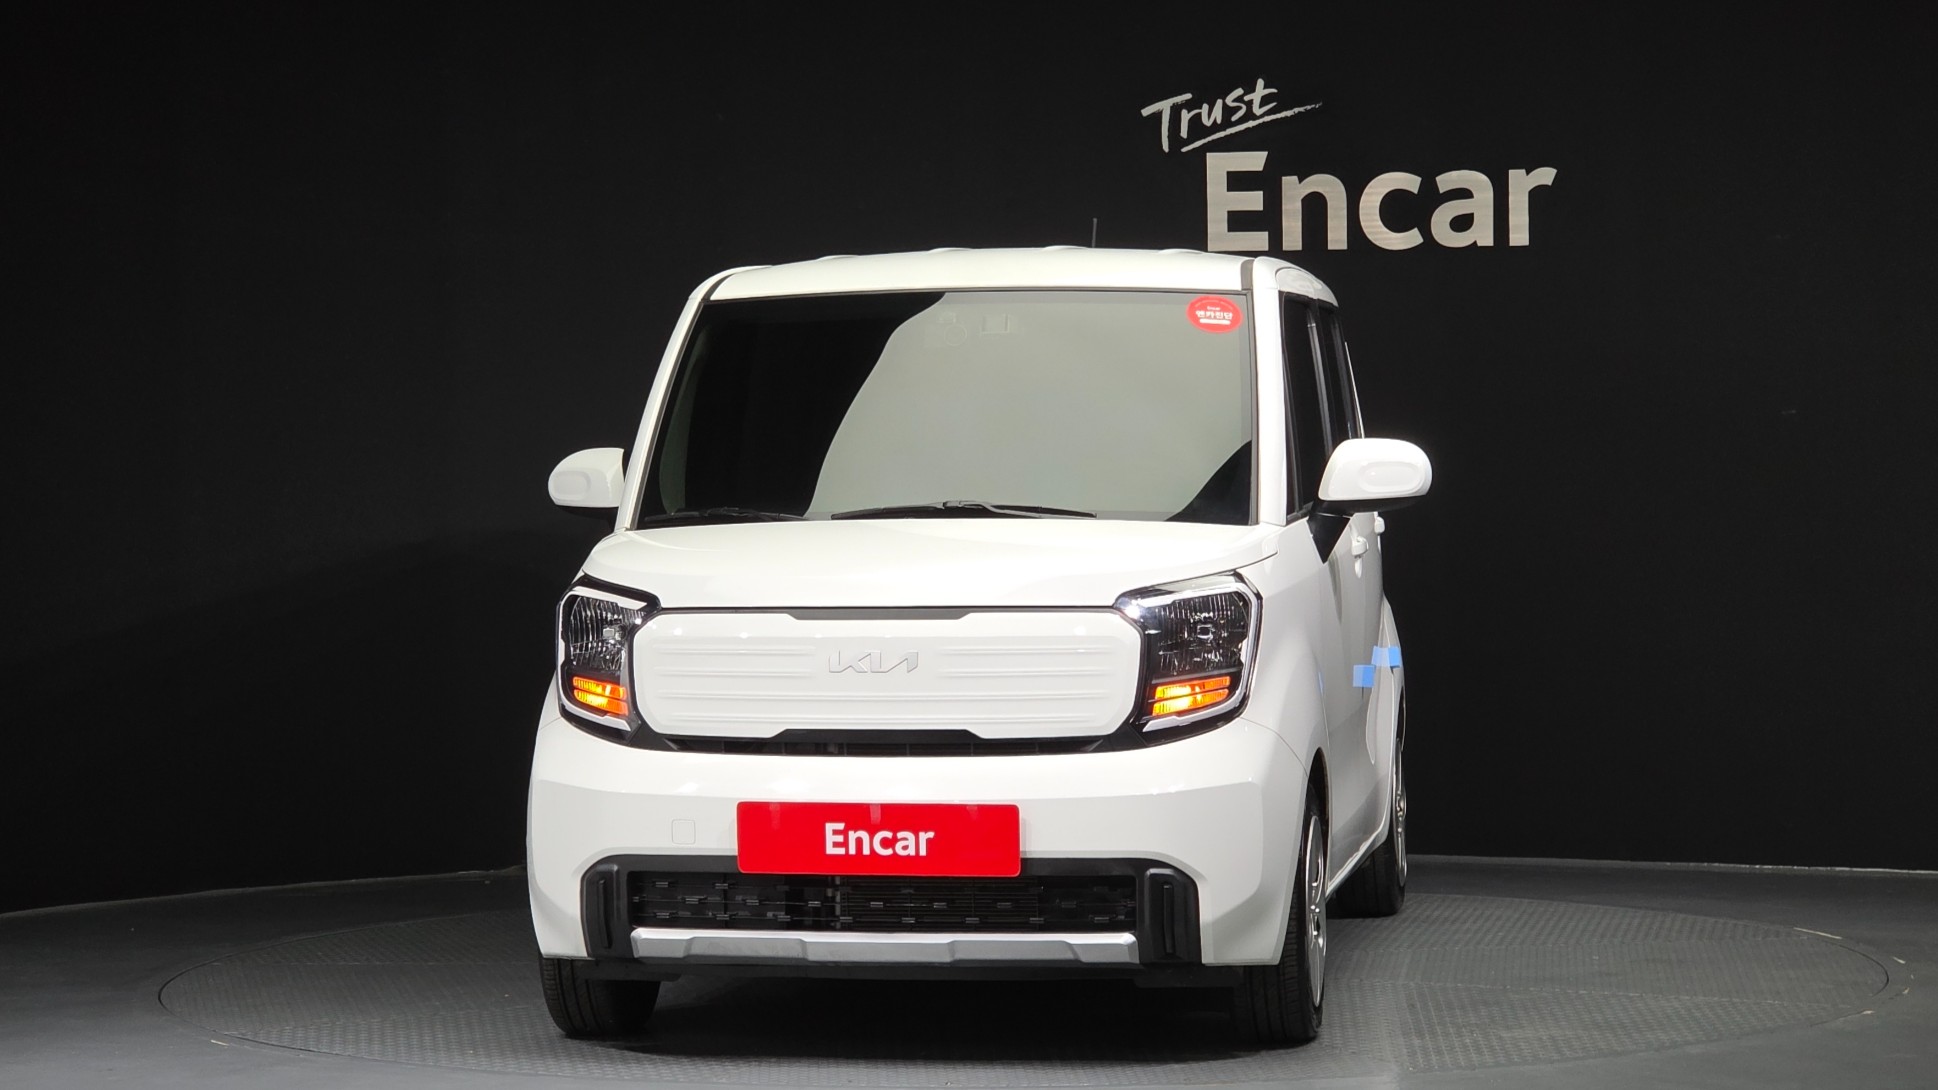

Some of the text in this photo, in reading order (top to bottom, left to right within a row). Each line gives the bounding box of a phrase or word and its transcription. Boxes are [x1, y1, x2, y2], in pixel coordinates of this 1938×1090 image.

[1140, 77, 1278, 153] Trust
[1206, 150, 1558, 252] Encar
[824, 822, 935, 857] Encar
